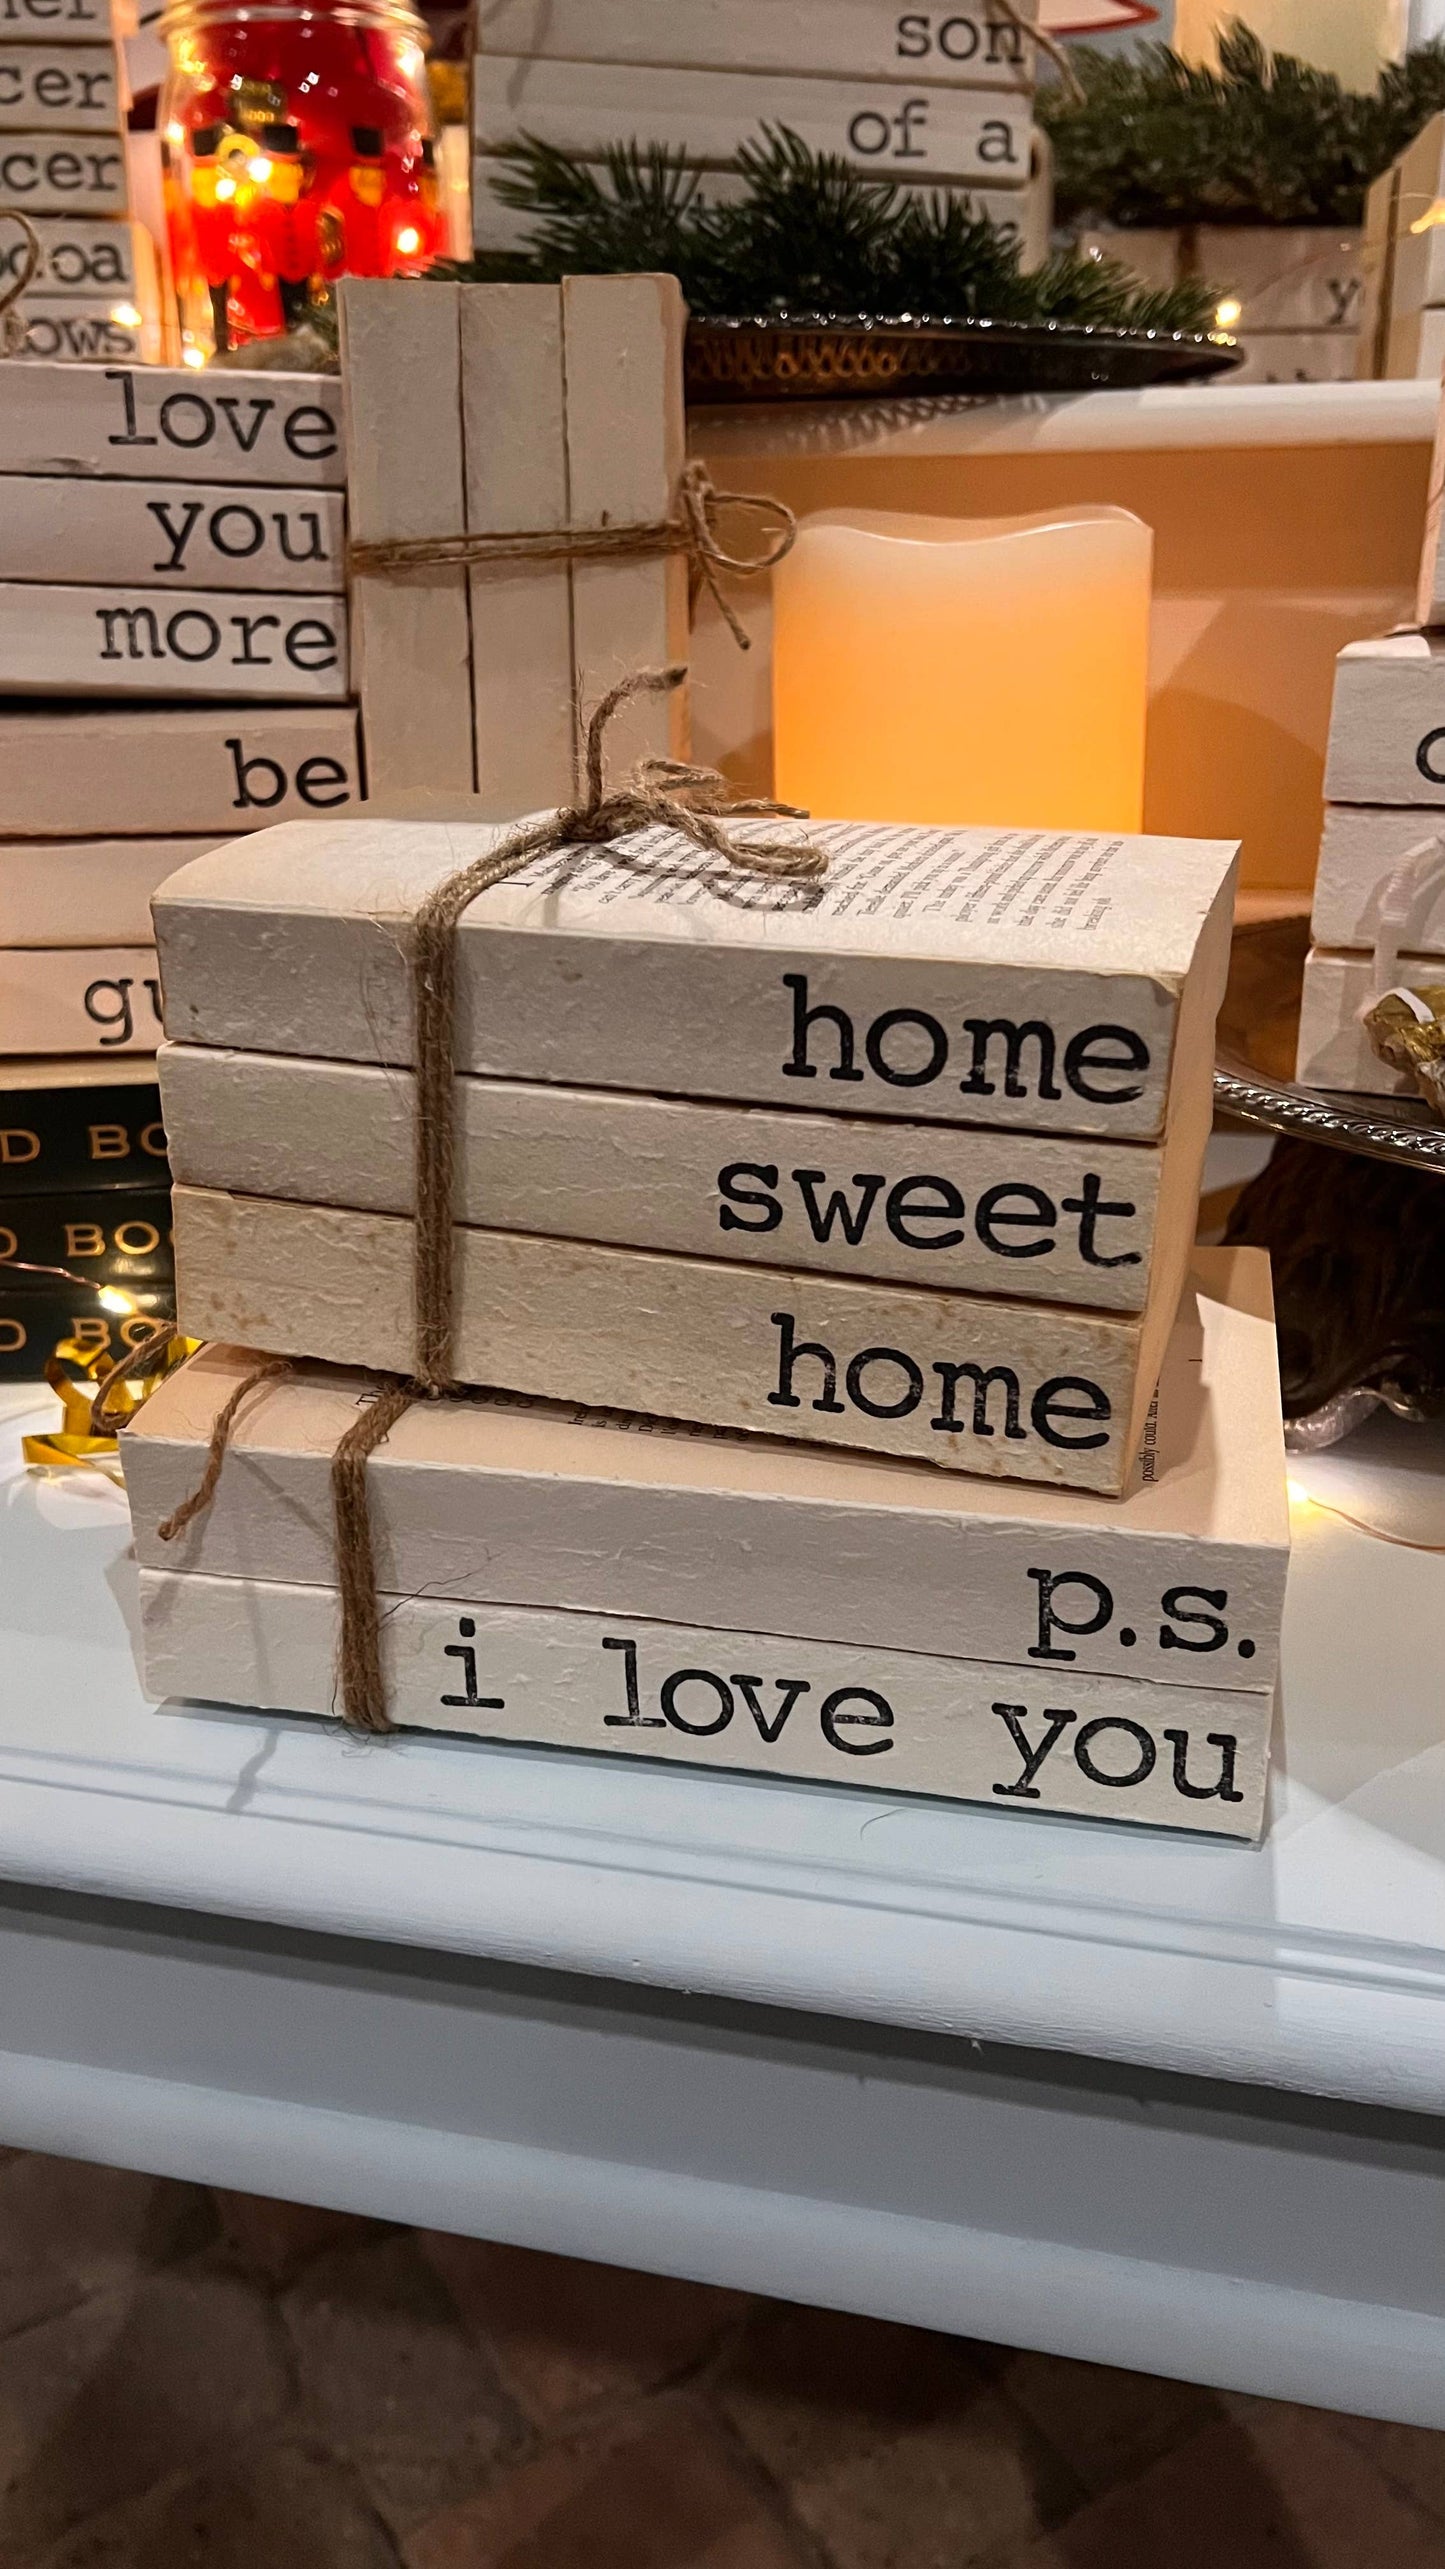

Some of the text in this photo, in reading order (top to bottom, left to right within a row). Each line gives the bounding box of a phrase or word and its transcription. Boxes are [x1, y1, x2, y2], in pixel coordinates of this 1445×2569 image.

[897, 14, 1025, 64] son
[848, 98, 1018, 165] of a
[104, 371, 338, 460] love
[146, 502, 329, 571] you
[96, 606, 338, 671] more
[225, 738, 350, 809] be
[782, 974, 1150, 1104] home
[718, 1162, 1142, 1268] sweet
[767, 1312, 1112, 1450] home
[1026, 1567, 1257, 1662] p.s.
[440, 1616, 1243, 1802] i love you
